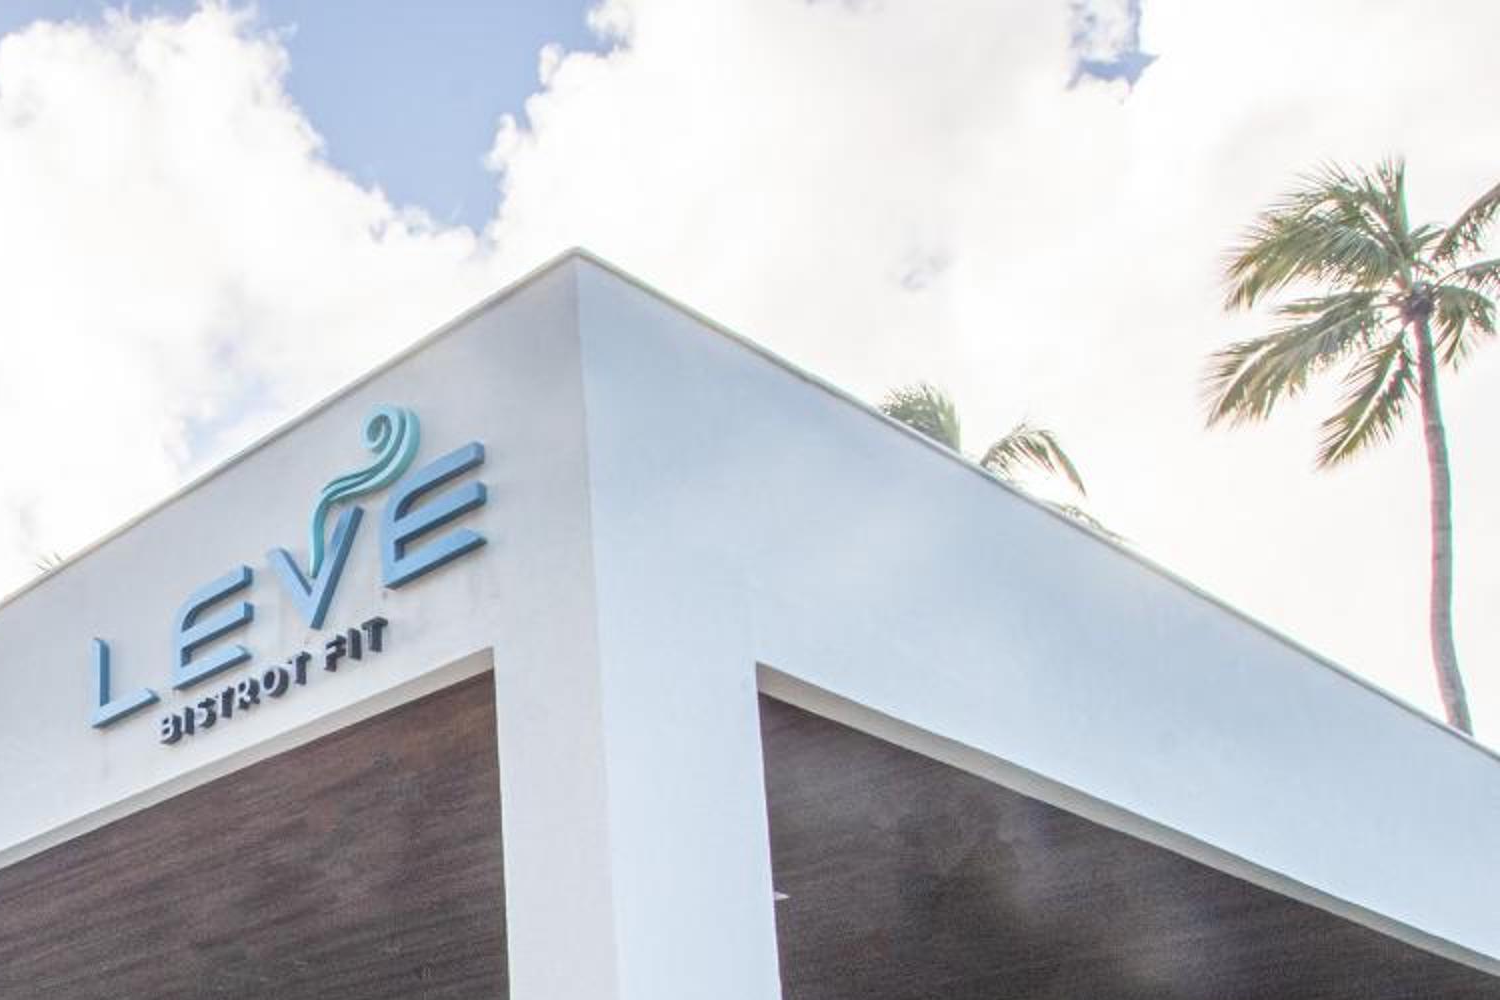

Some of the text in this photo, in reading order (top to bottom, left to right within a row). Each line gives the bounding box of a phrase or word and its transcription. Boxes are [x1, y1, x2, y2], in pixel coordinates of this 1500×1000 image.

[92, 440, 487, 728] LEVE
[158, 616, 389, 745] BISTROT FIT
